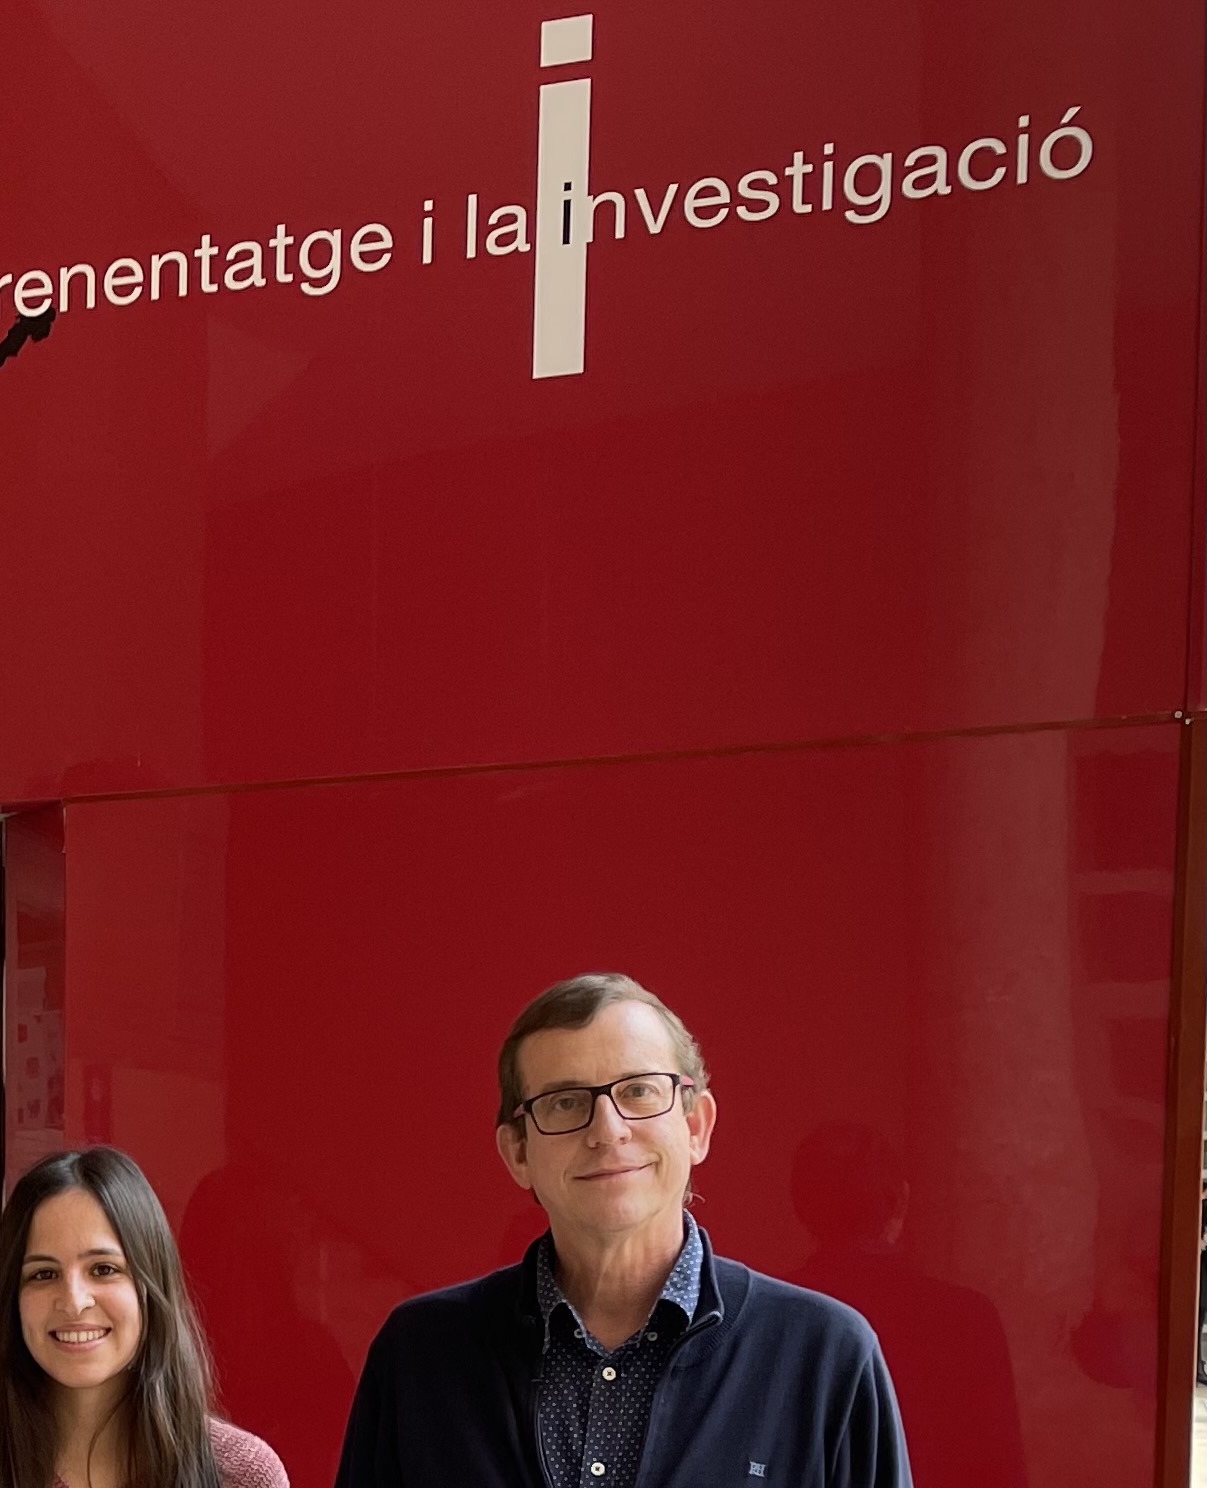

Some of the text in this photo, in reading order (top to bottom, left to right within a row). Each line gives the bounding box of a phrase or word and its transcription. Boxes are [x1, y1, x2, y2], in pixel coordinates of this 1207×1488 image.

[422, 200, 434, 264] i
[466, 194, 531, 260] la
[562, 106, 1093, 246] investigació
